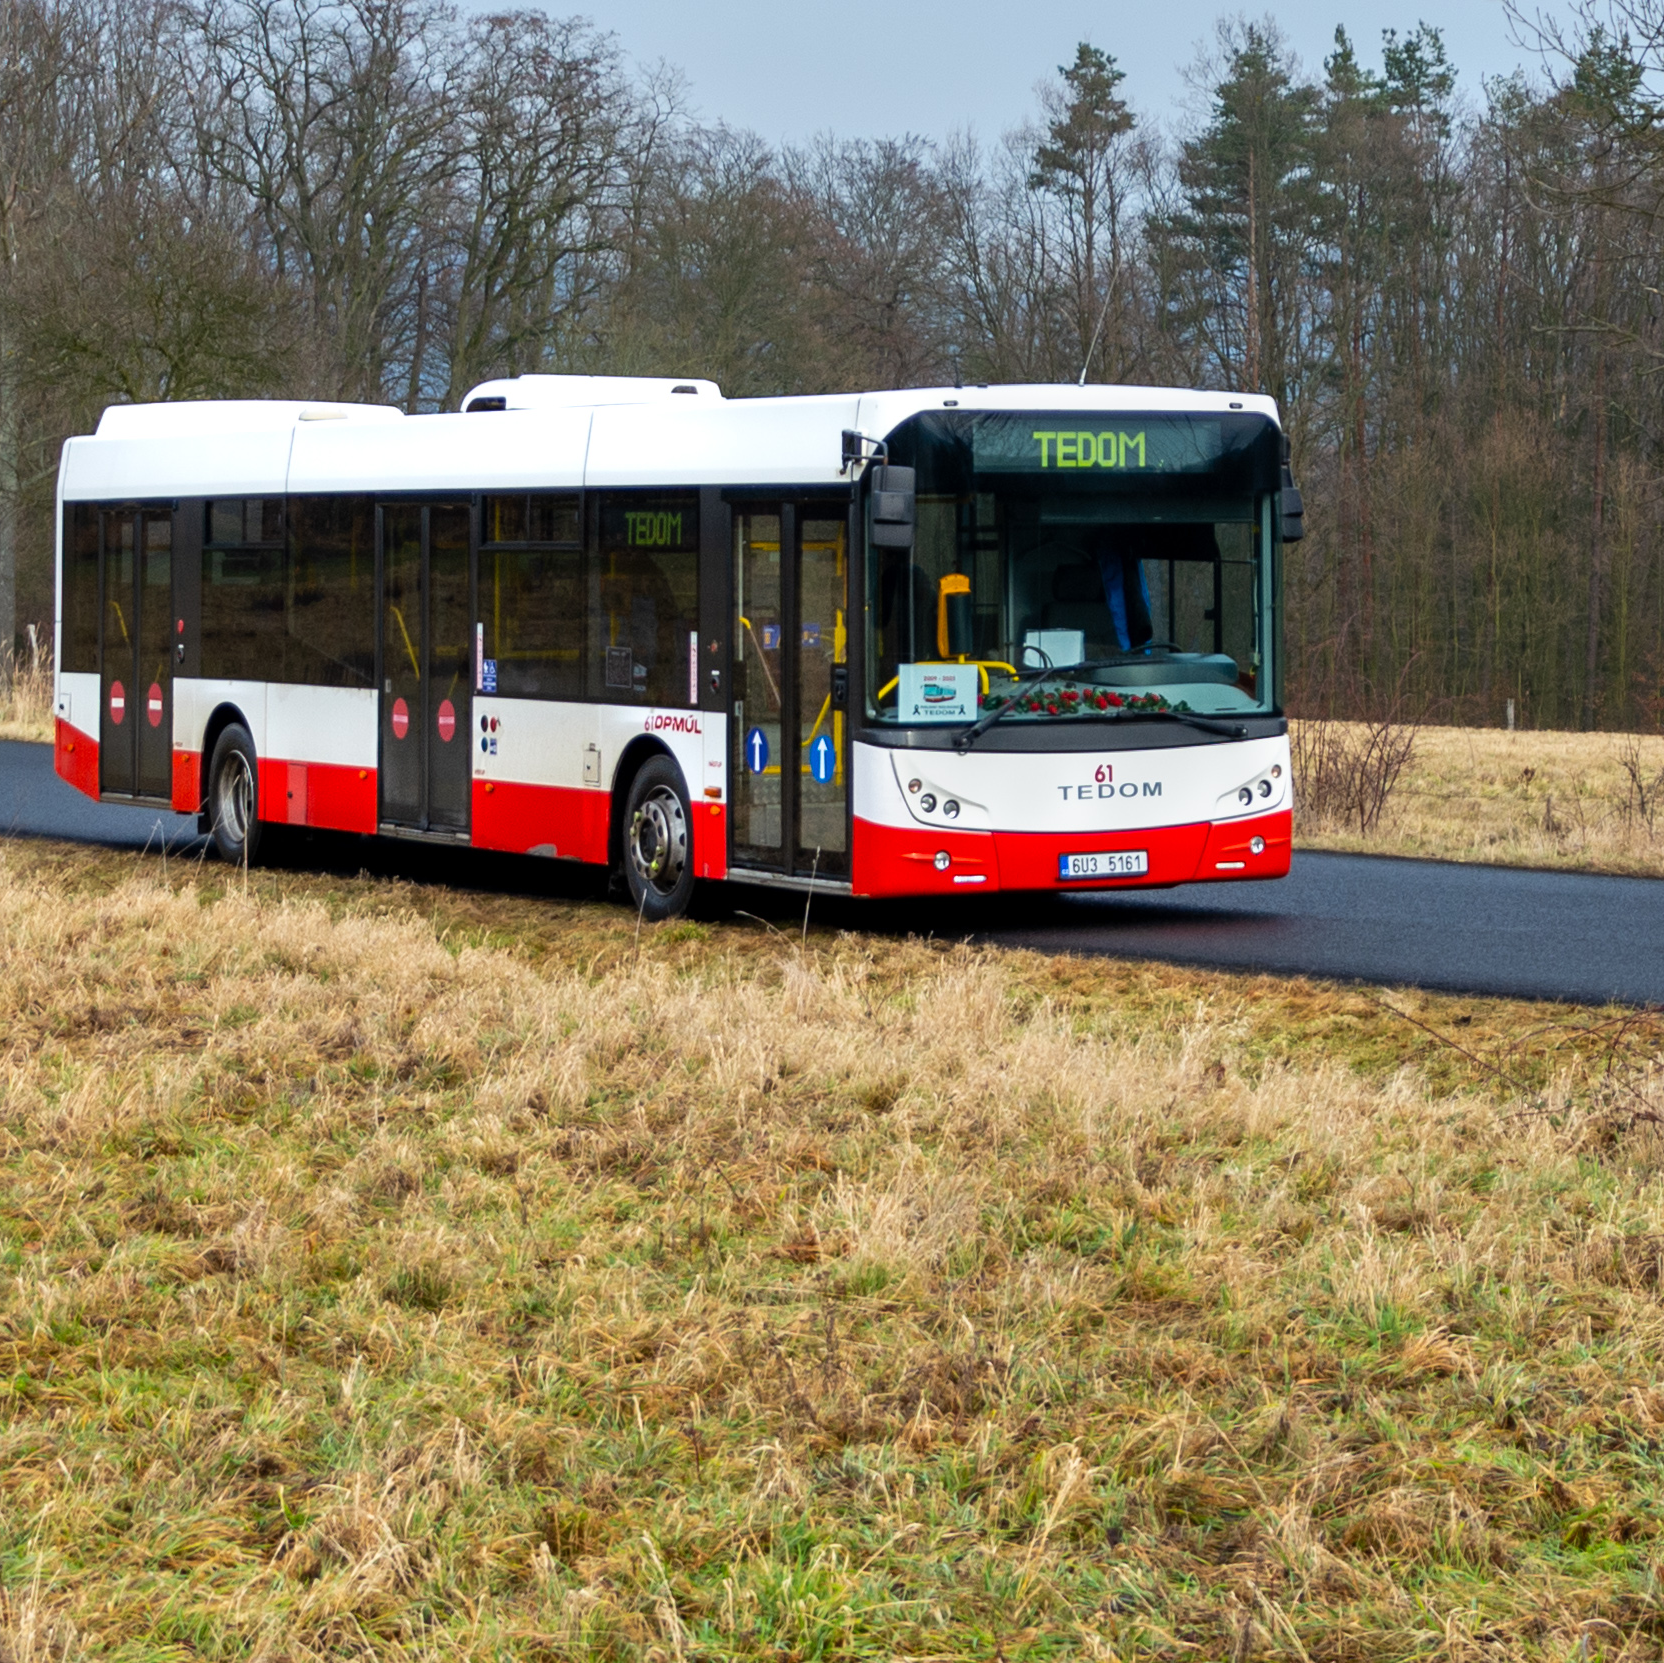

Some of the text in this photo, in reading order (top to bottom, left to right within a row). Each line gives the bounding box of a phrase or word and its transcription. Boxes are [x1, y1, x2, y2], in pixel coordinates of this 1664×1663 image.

[1033, 431, 1146, 468] TEDOM
[624, 511, 682, 545] TEDOM
[655, 715, 702, 734] DPMÚL
[1094, 764, 1113, 783] 61
[1057, 782, 1162, 801] TEDOM
[1072, 855, 1141, 874] 6U3 5161
